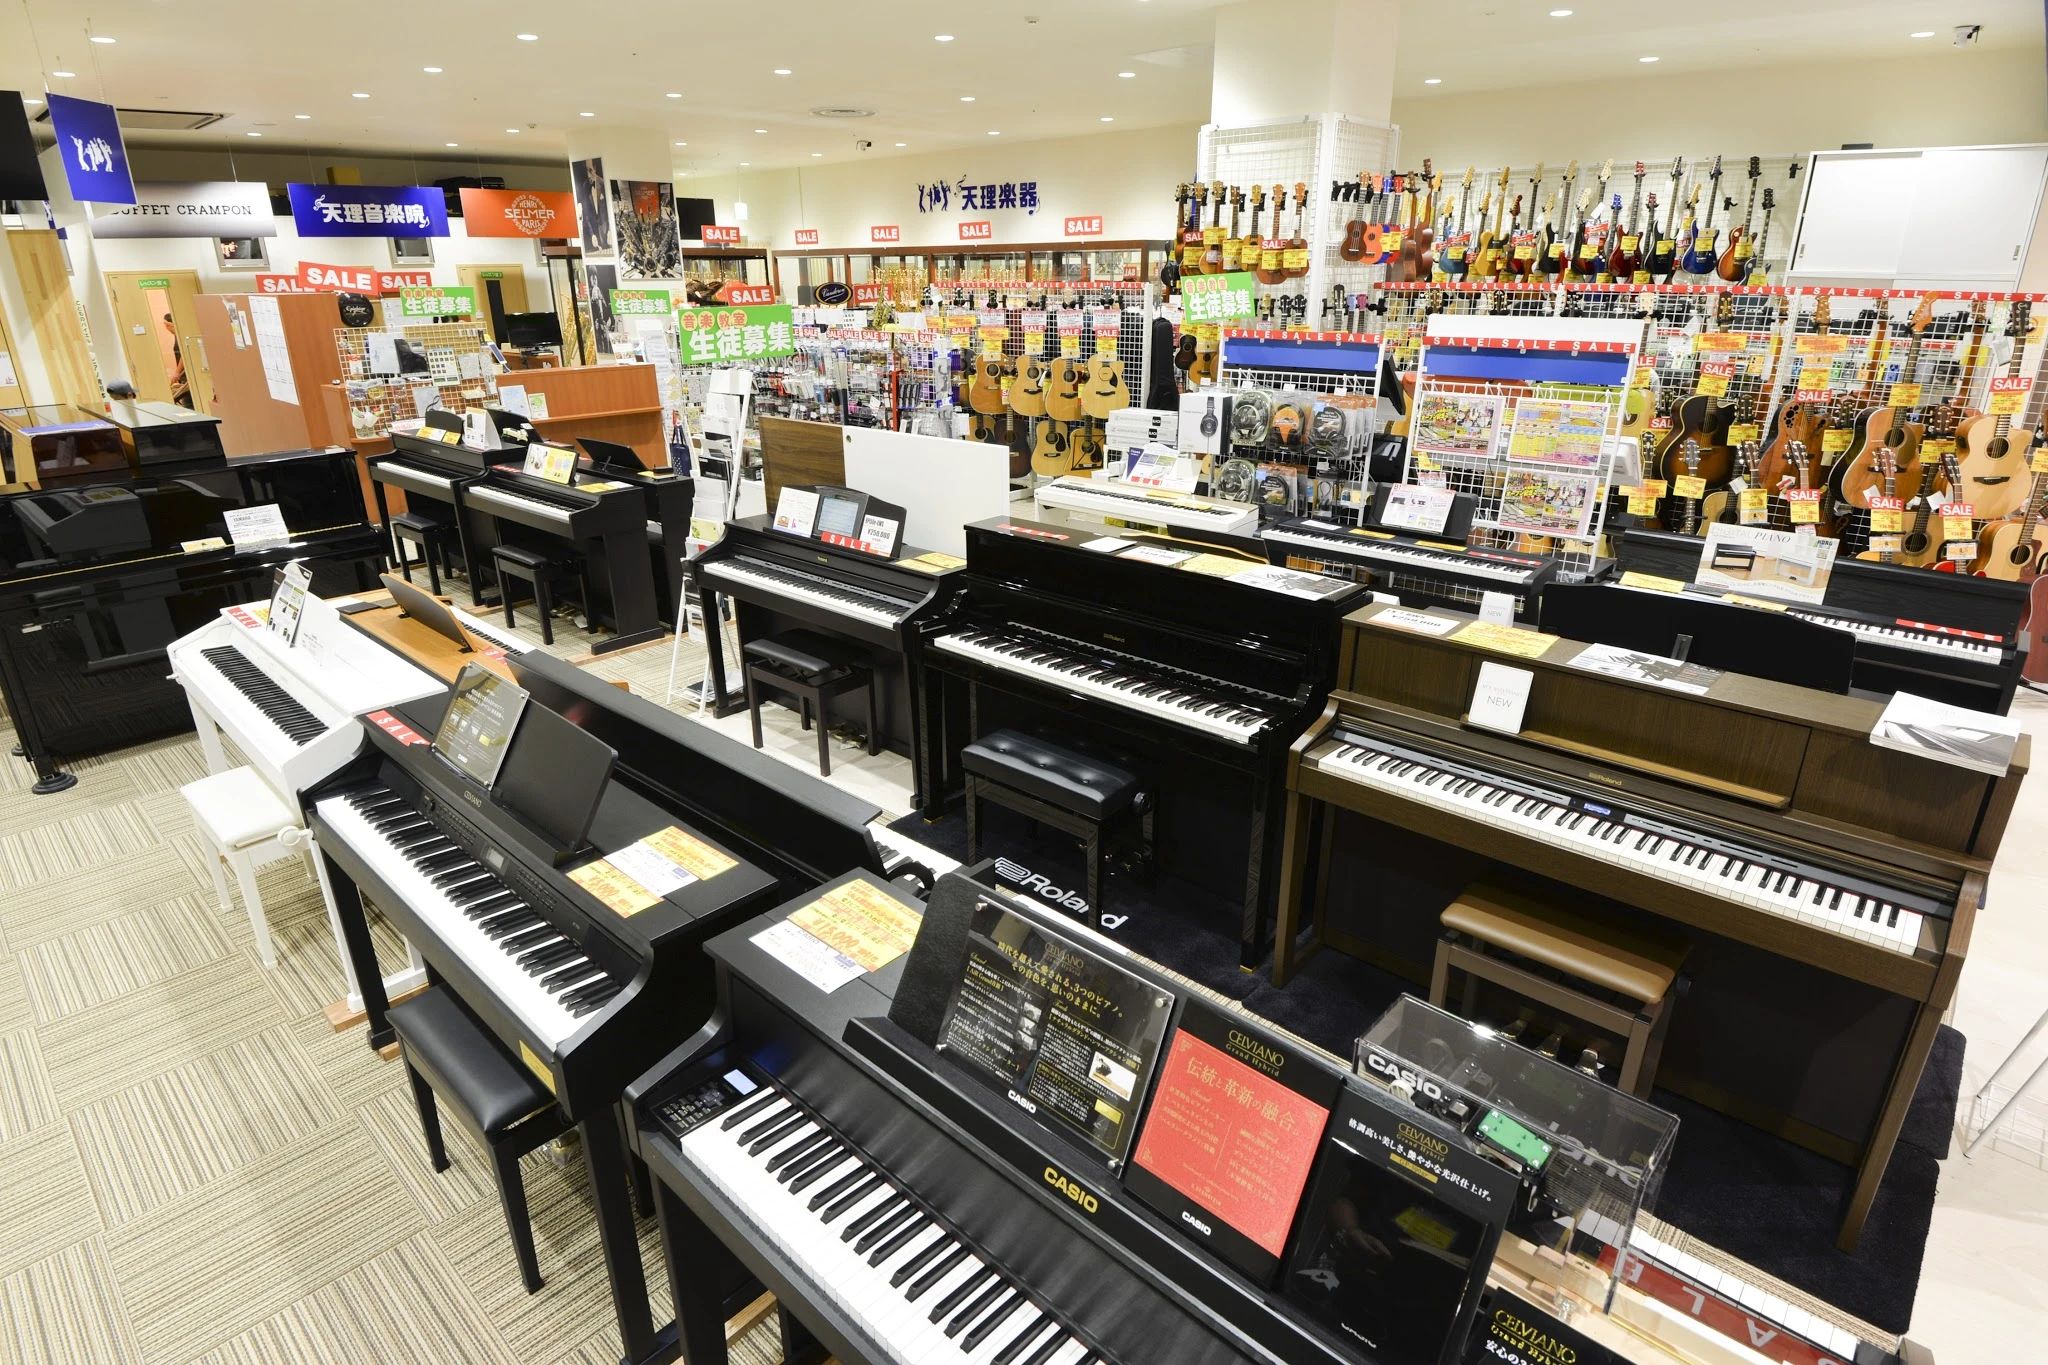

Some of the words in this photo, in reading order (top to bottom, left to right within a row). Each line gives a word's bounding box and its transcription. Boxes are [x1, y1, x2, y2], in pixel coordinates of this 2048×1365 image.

[962, 182, 1038, 210] 天理楽器
[177, 204, 252, 216] CRAMPON
[504, 208, 556, 219] SELMER
[962, 224, 989, 239] SALE
[1067, 219, 1100, 234] SALE
[705, 228, 737, 241] SALE
[797, 232, 817, 242] SALE
[873, 227, 898, 240] SALE
[1185, 233, 1203, 242] SAL
[307, 267, 372, 290] SALE
[381, 275, 427, 289] SALE
[264, 278, 316, 292] SAL
[1472, 282, 1505, 290] SALE
[1629, 284, 1673, 292] SALE
[1743, 285, 1791, 295] SALE
[732, 287, 771, 304] SALE
[1813, 288, 1864, 297] SALE
[1882, 289, 1923, 298] SAL
[1954, 292, 2012, 301] SALE
[405, 297, 472, 315] 生徒募集
[1189, 289, 1250, 320] 生徒募集
[683, 311, 747, 330] 音楽教室
[827, 330, 842, 338] SALE
[844, 331, 859, 339] SALE
[1024, 325, 1044, 333] SALE
[1097, 329, 1118, 337] SALE
[1232, 329, 1271, 339] SALE
[689, 321, 791, 361] 生徒募集
[862, 332, 878, 340] SALE
[920, 334, 937, 342] SALE
[1282, 331, 1324, 340] SALE
[1335, 333, 1380, 343] SALE
[1434, 336, 1484, 346] SALE
[1502, 338, 1556, 349] SALE
[1572, 341, 1631, 353] SALE
[1703, 363, 1733, 378] SALE
[1993, 379, 2029, 390] SALE
[1798, 390, 1830, 401] SALE
[1651, 418, 1672, 428] SAL
[1789, 490, 1820, 501] SALE
[1871, 498, 1902, 509] SALE
[1942, 505, 1973, 516] SALE
[830, 534, 866, 551] SALE
[1754, 532, 1791, 543] PIANO
[1487, 695, 1513, 708] NEW
[1020, 873, 1129, 930] Rolad
[1228, 1029, 1285, 1067] CELVIANO
[1225, 1043, 1249, 1061] Grand
[1252, 1057, 1280, 1077] Hybrid
[1368, 1053, 1442, 1100] CASIO
[1008, 1089, 1037, 1114] CASIO
[1186, 1056, 1300, 1137] 伝統と革新の融合。
[1398, 1122, 1449, 1155] CELVIANO
[1348, 1117, 1492, 1202] 格調高い美しさ、艶やかな光沢仕上げ。
[1043, 1166, 1098, 1214] CASIO
[1181, 1211, 1212, 1236] CASIO
[1495, 1310, 1577, 1364] CELVIANO
